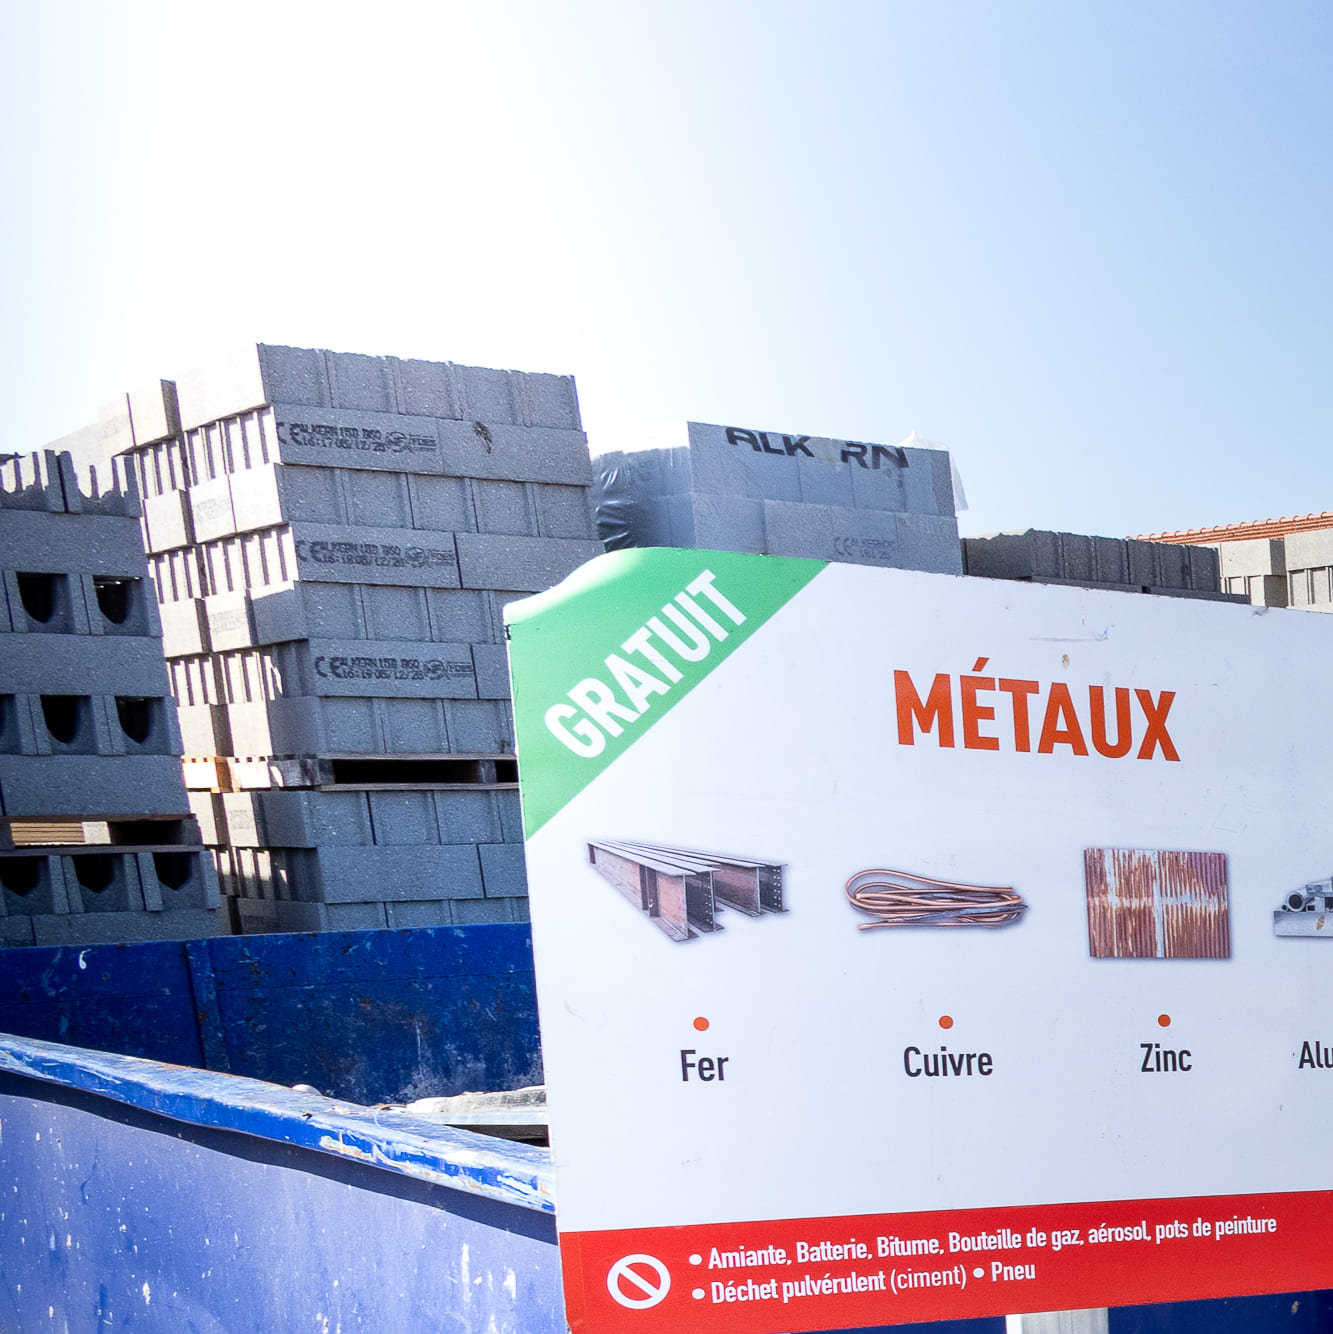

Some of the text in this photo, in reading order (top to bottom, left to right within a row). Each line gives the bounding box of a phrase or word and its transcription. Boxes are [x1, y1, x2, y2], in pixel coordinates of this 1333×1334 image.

[725, 427, 909, 469] ALKRN
[543, 568, 748, 759] GRATUIT
[893, 656, 1181, 762] MÉTAUX
[680, 1049, 729, 1082] Fer
[903, 1046, 993, 1077] Cuivre
[1140, 1043, 1192, 1072] Zinc
[708, 1214, 1277, 1270] Amiante, Batterie, Bitume, Bouteille de gaz, aérosol, pots de peinture
[710, 1261, 1036, 1304] Déchet pulvérulent (ciment) Pneu
